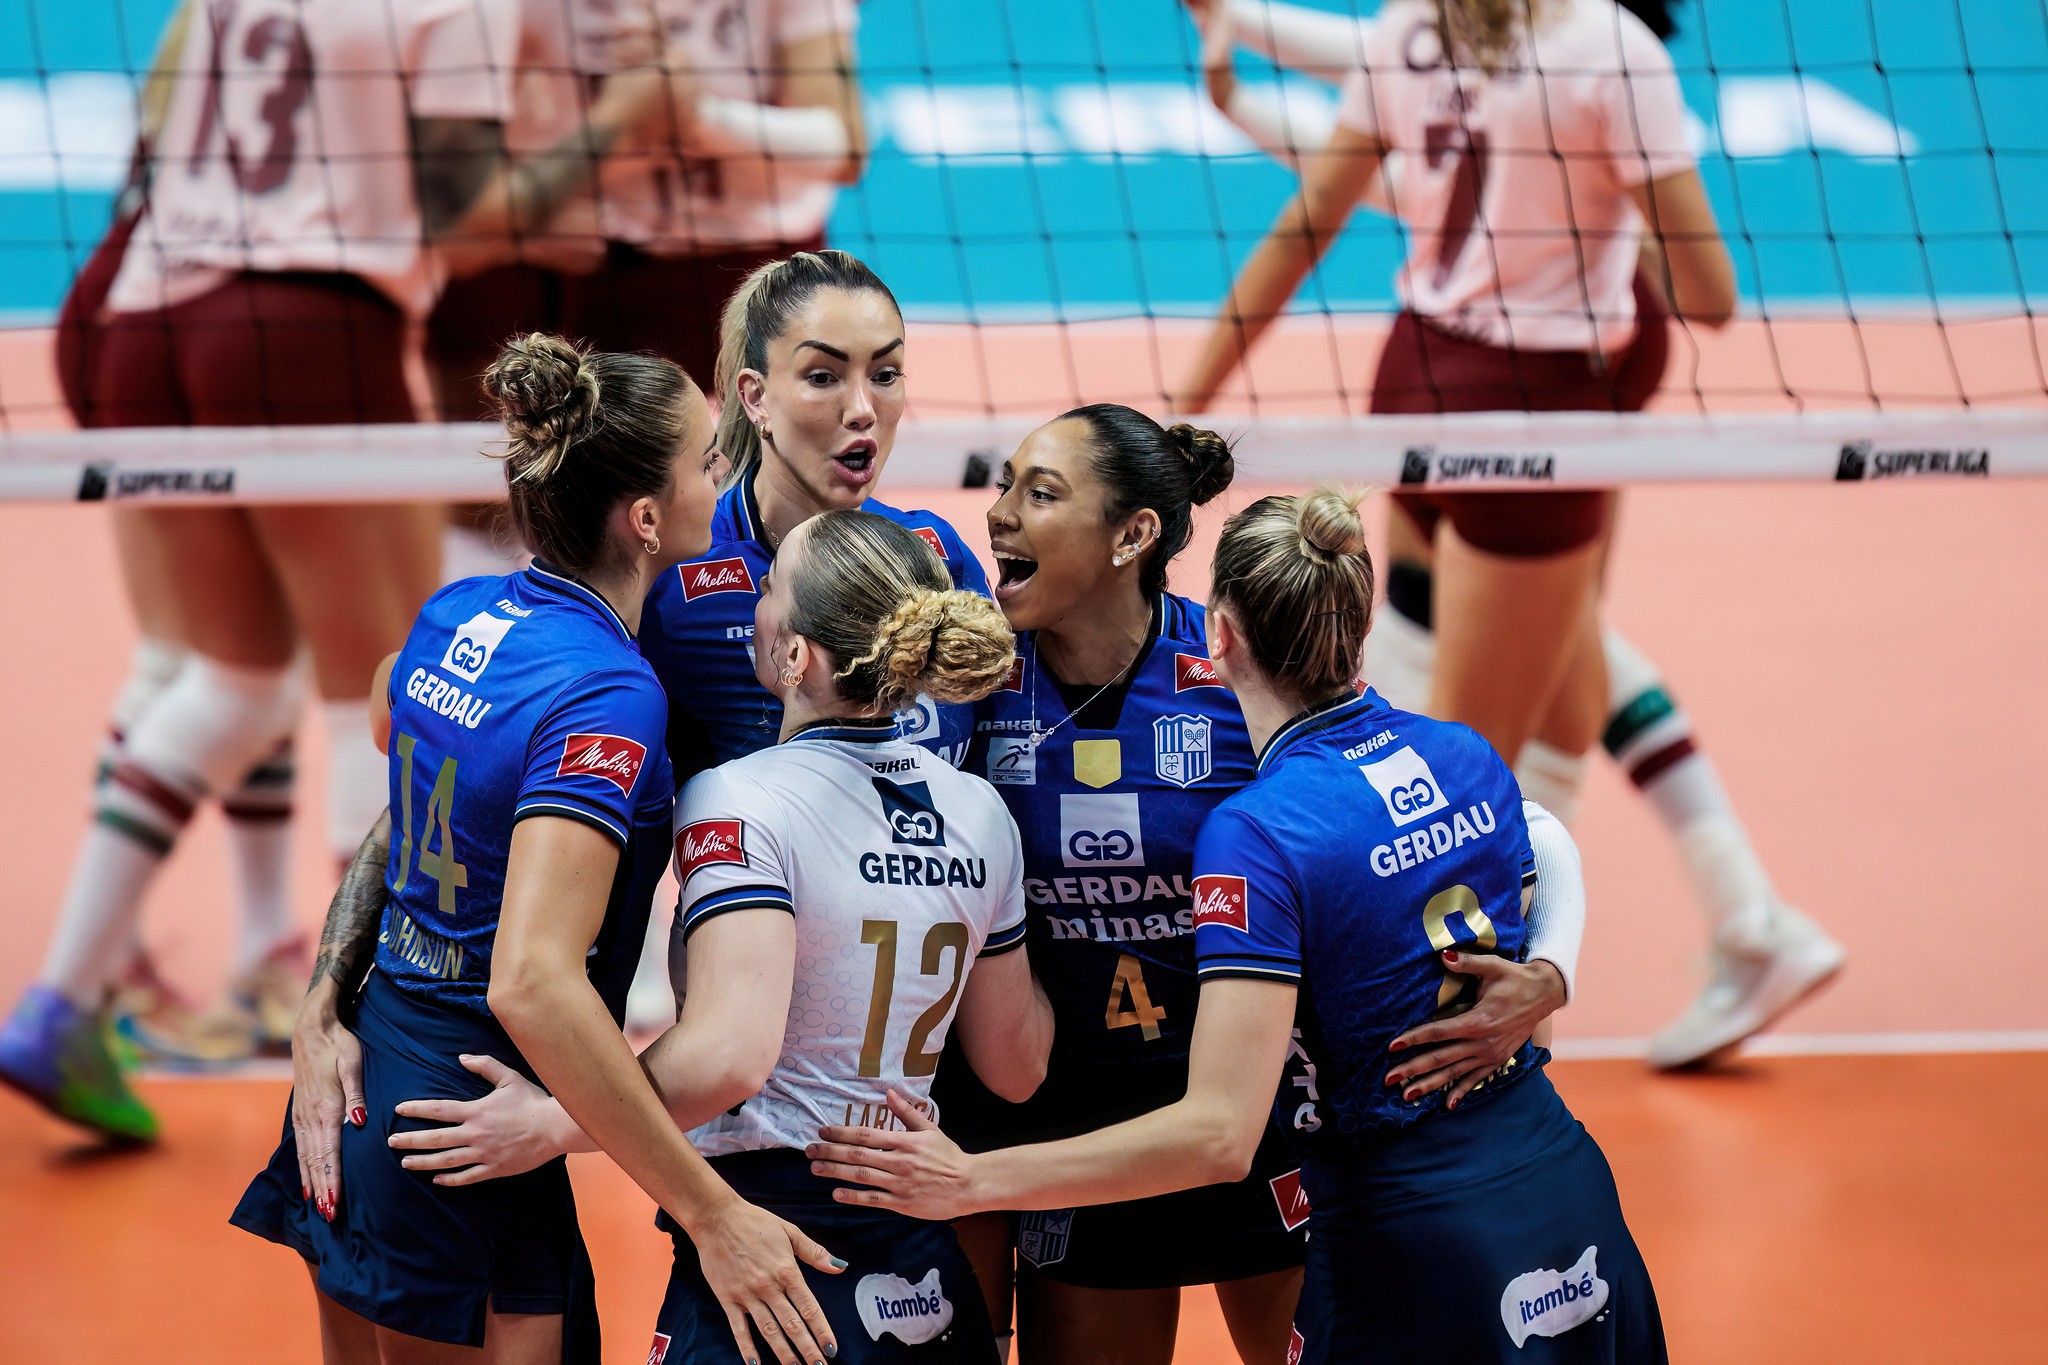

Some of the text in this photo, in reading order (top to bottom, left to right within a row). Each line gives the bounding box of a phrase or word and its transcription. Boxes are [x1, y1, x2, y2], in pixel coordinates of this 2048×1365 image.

[1424, 122, 1489, 291] 7
[1436, 452, 1556, 483] SUPERLIGA
[1870, 449, 1990, 480] SUPERLIGA
[691, 567, 742, 590] Melitta
[406, 667, 493, 729] GERDAU
[569, 740, 632, 778] Melitta
[394, 732, 468, 915] 14
[1370, 800, 1497, 878] GERDAU
[681, 830, 731, 873] Melitta
[859, 851, 987, 889] GERDAU
[1193, 884, 1236, 917] Melitta
[1046, 908, 1196, 943] minas
[858, 919, 970, 1078] 12
[1105, 953, 1167, 1042] 4
[876, 1289, 941, 1320] itambé
[1519, 1271, 1594, 1326] itambé
